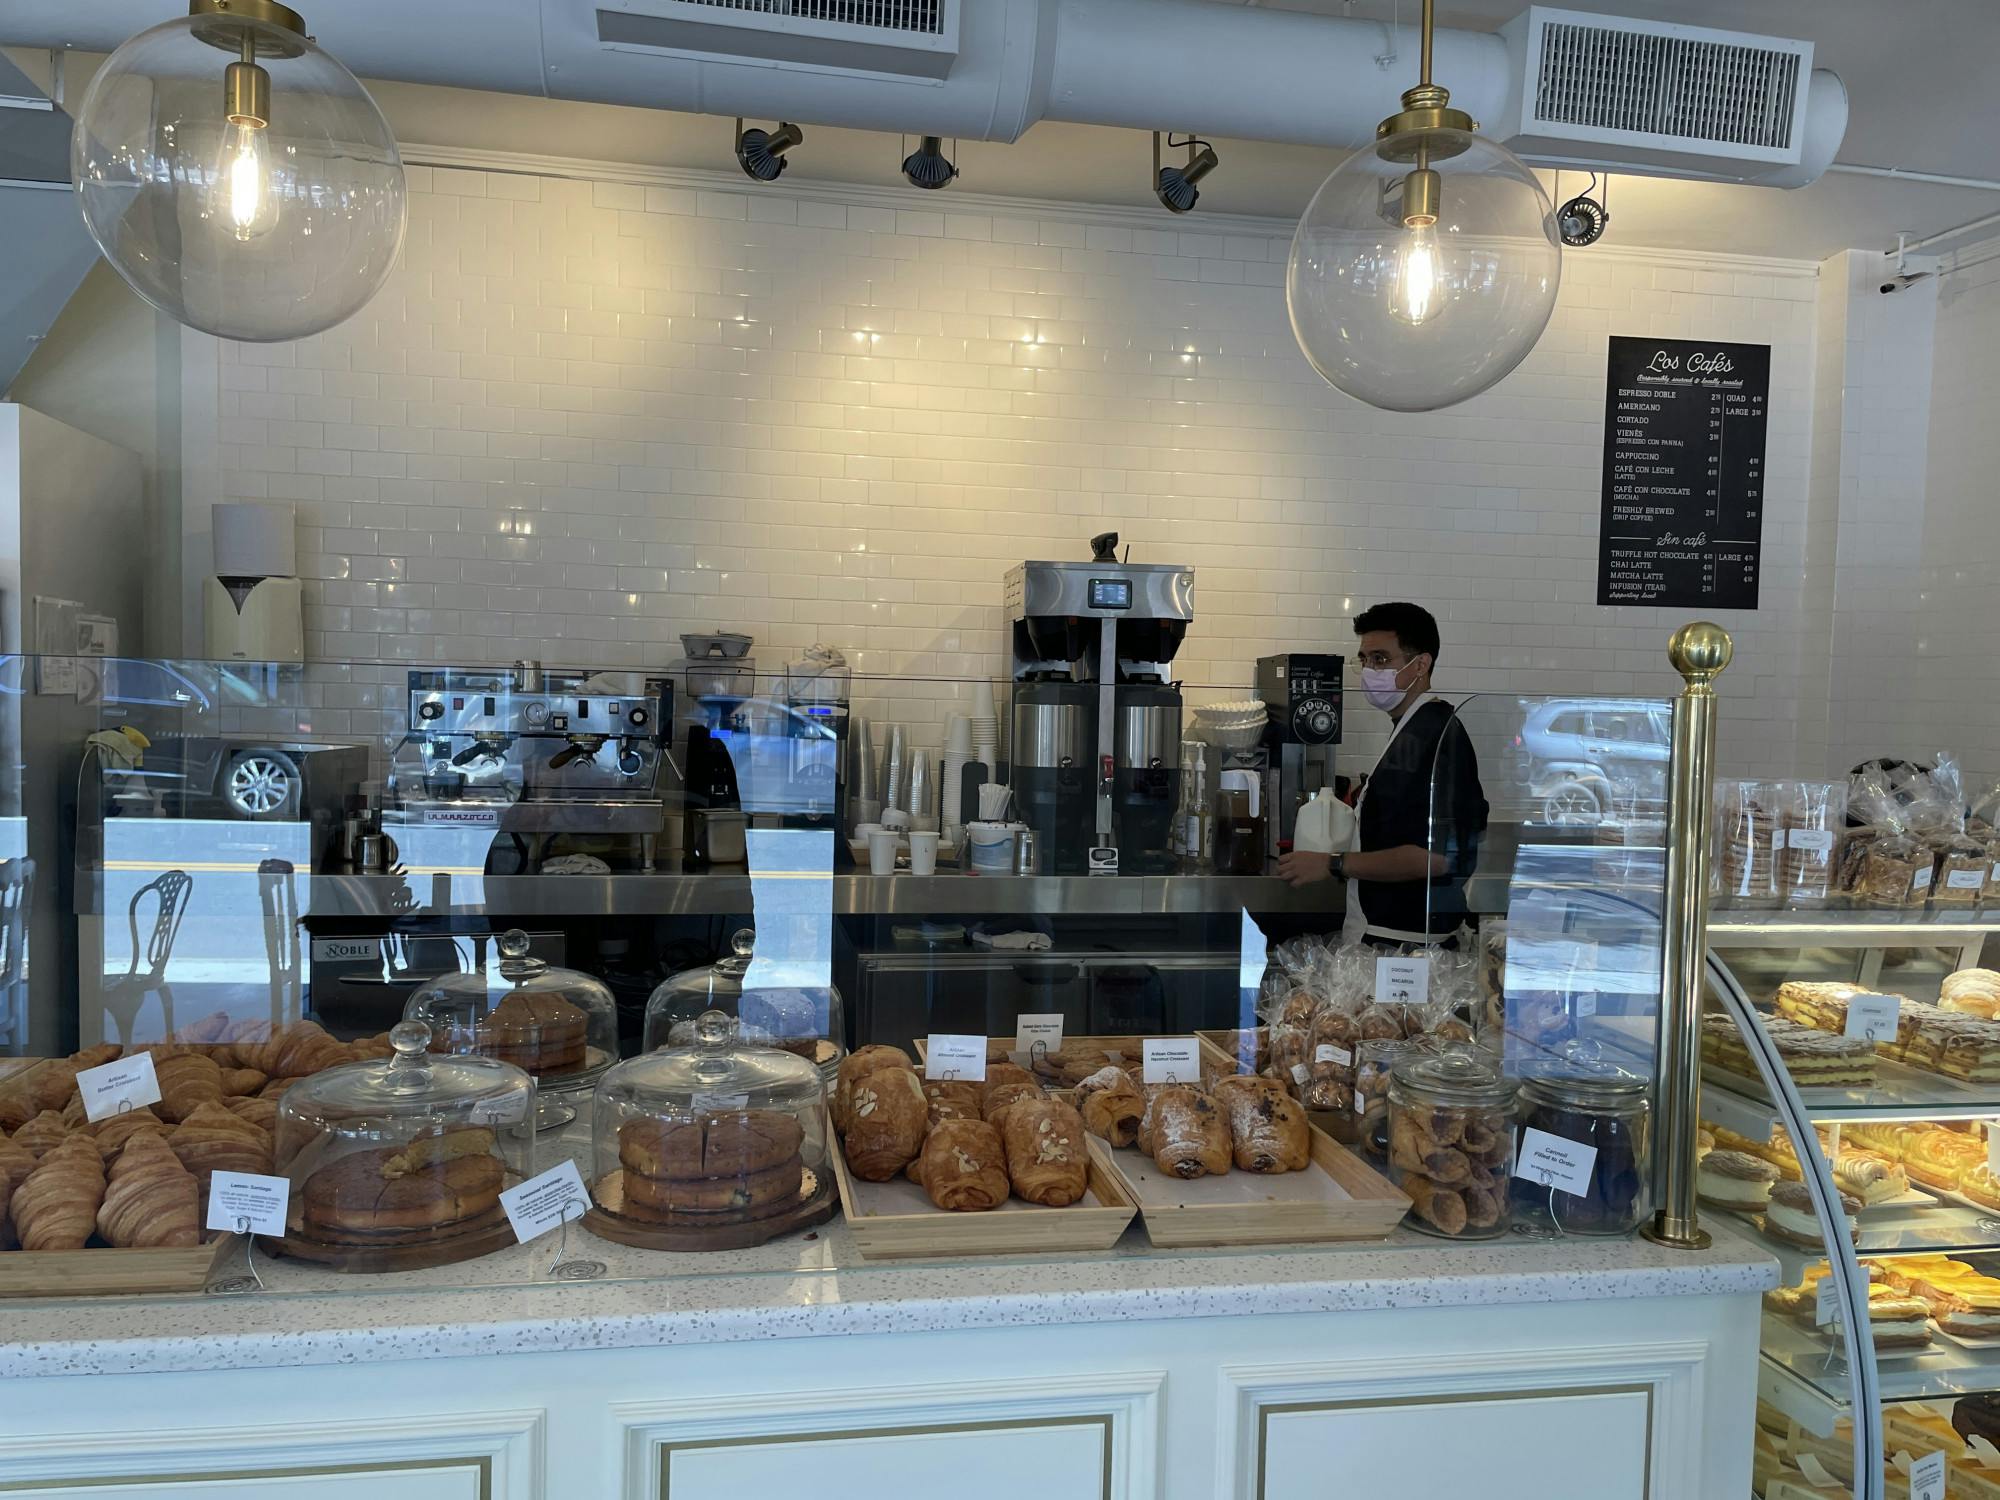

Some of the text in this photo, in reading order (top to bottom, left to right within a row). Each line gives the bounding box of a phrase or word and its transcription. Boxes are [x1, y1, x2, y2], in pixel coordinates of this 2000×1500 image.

[1646, 350, 1734, 374] Los Cafés
[1618, 389, 1652, 397] ESPRESSO
[1618, 402, 1661, 411] AMERICANO
[1617, 416, 1649, 424] CORTADO
[1617, 428, 1643, 437] VIENÉS
[1616, 452, 1659, 460] CAPPUCCINO
[1614, 464, 1633, 472] CAFÉ
[1614, 485, 1632, 493] CAFÉ
[1651, 487, 1690, 495] CHOCOLATE
[1656, 532, 1707, 548] Sin café
[327, 944, 370, 956] NOBLE
[1558, 1158, 1576, 1168] Order
